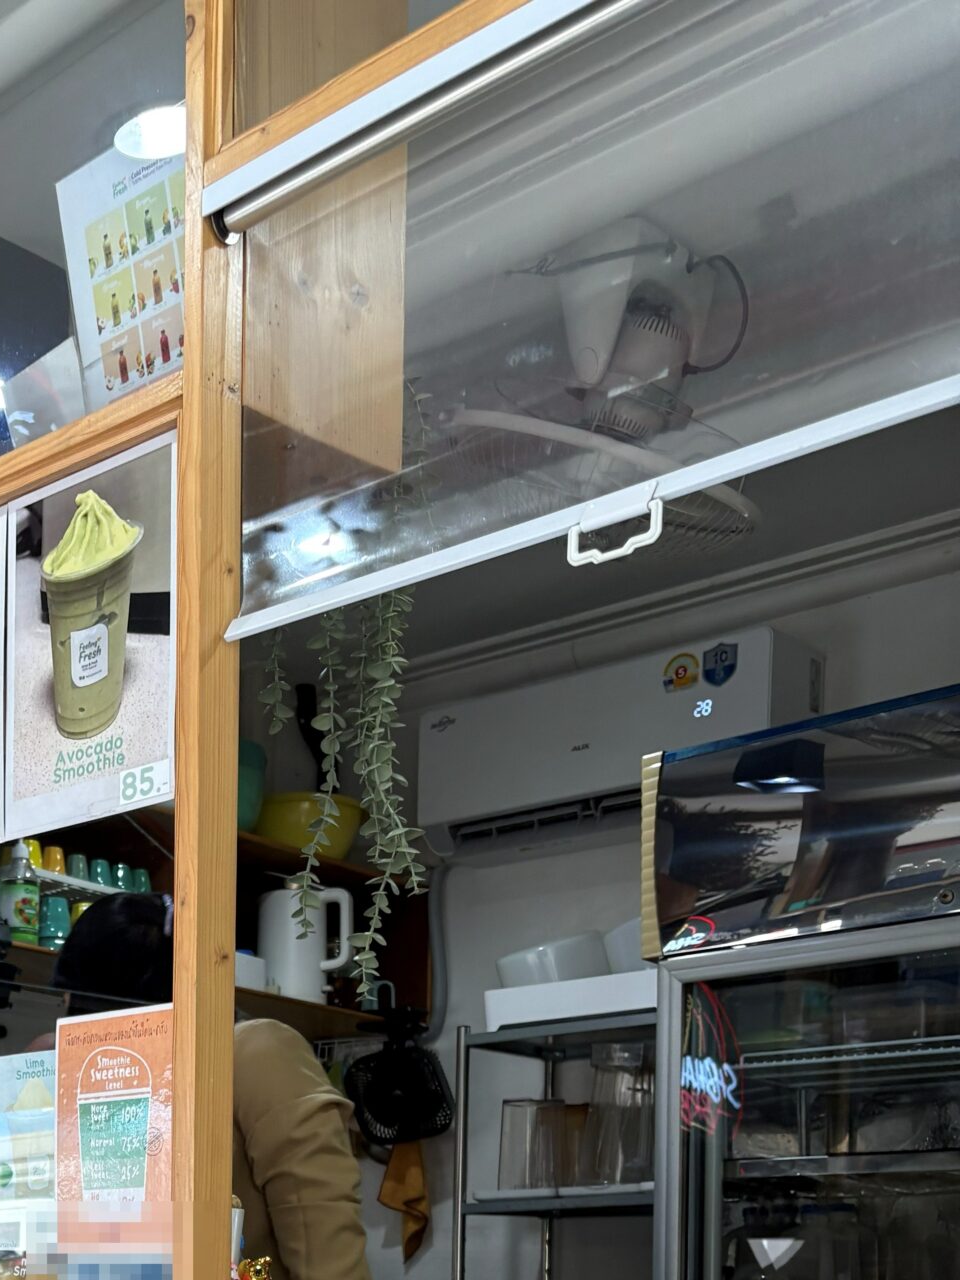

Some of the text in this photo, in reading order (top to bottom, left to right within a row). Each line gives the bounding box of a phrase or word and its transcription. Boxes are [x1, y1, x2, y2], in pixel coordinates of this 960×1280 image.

[79, 645, 102, 664] Fresh
[693, 699, 713, 718] 28
[55, 735, 124, 767] Avocado
[53, 751, 126, 785] Smoothie
[25, 1057, 45, 1069] Lime
[97, 1055, 131, 1068] Smoothie
[90, 1066, 139, 1083] Sweetness
